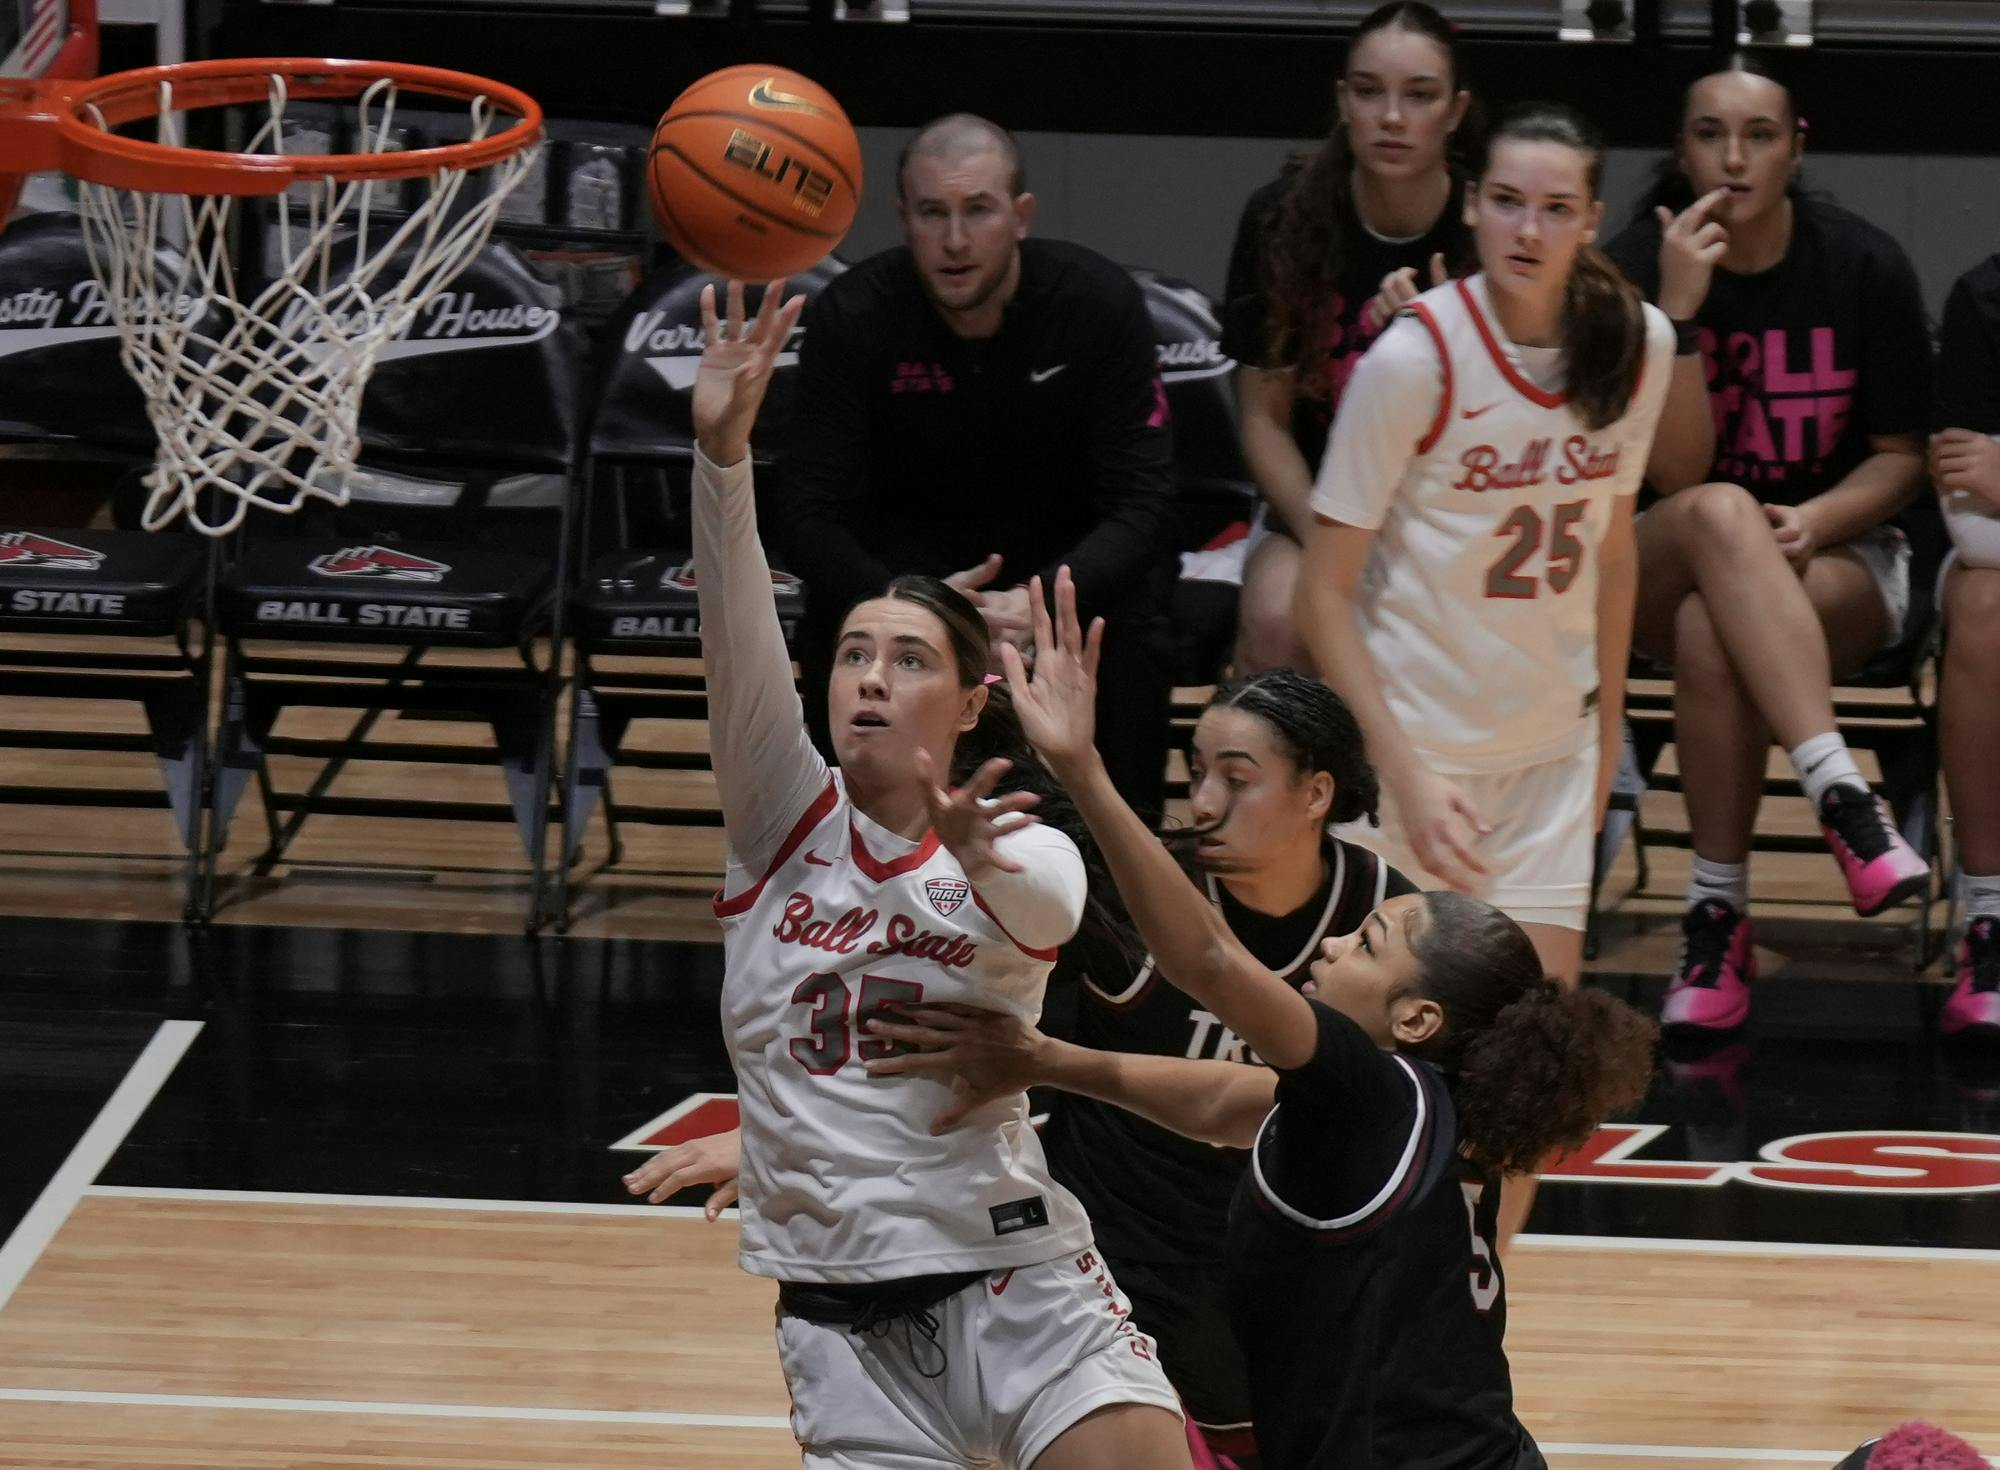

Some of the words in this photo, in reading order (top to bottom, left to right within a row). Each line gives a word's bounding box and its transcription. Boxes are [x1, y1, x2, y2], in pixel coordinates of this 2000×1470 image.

[724, 128, 833, 208] ELITE
[425, 292, 545, 338] House
[1155, 341, 1227, 364] ouse
[1453, 437, 1552, 492] Ball
[1483, 498, 1592, 599] 25
[12, 589, 126, 615] STATE
[257, 601, 350, 624] BALL
[358, 604, 471, 628] STATE
[612, 616, 701, 638] BALL
[928, 888, 967, 900] MAC
[773, 892, 879, 954] Ball
[866, 914, 978, 967] State
[789, 972, 924, 1076] 35
[1185, 1009, 1265, 1064] TR
